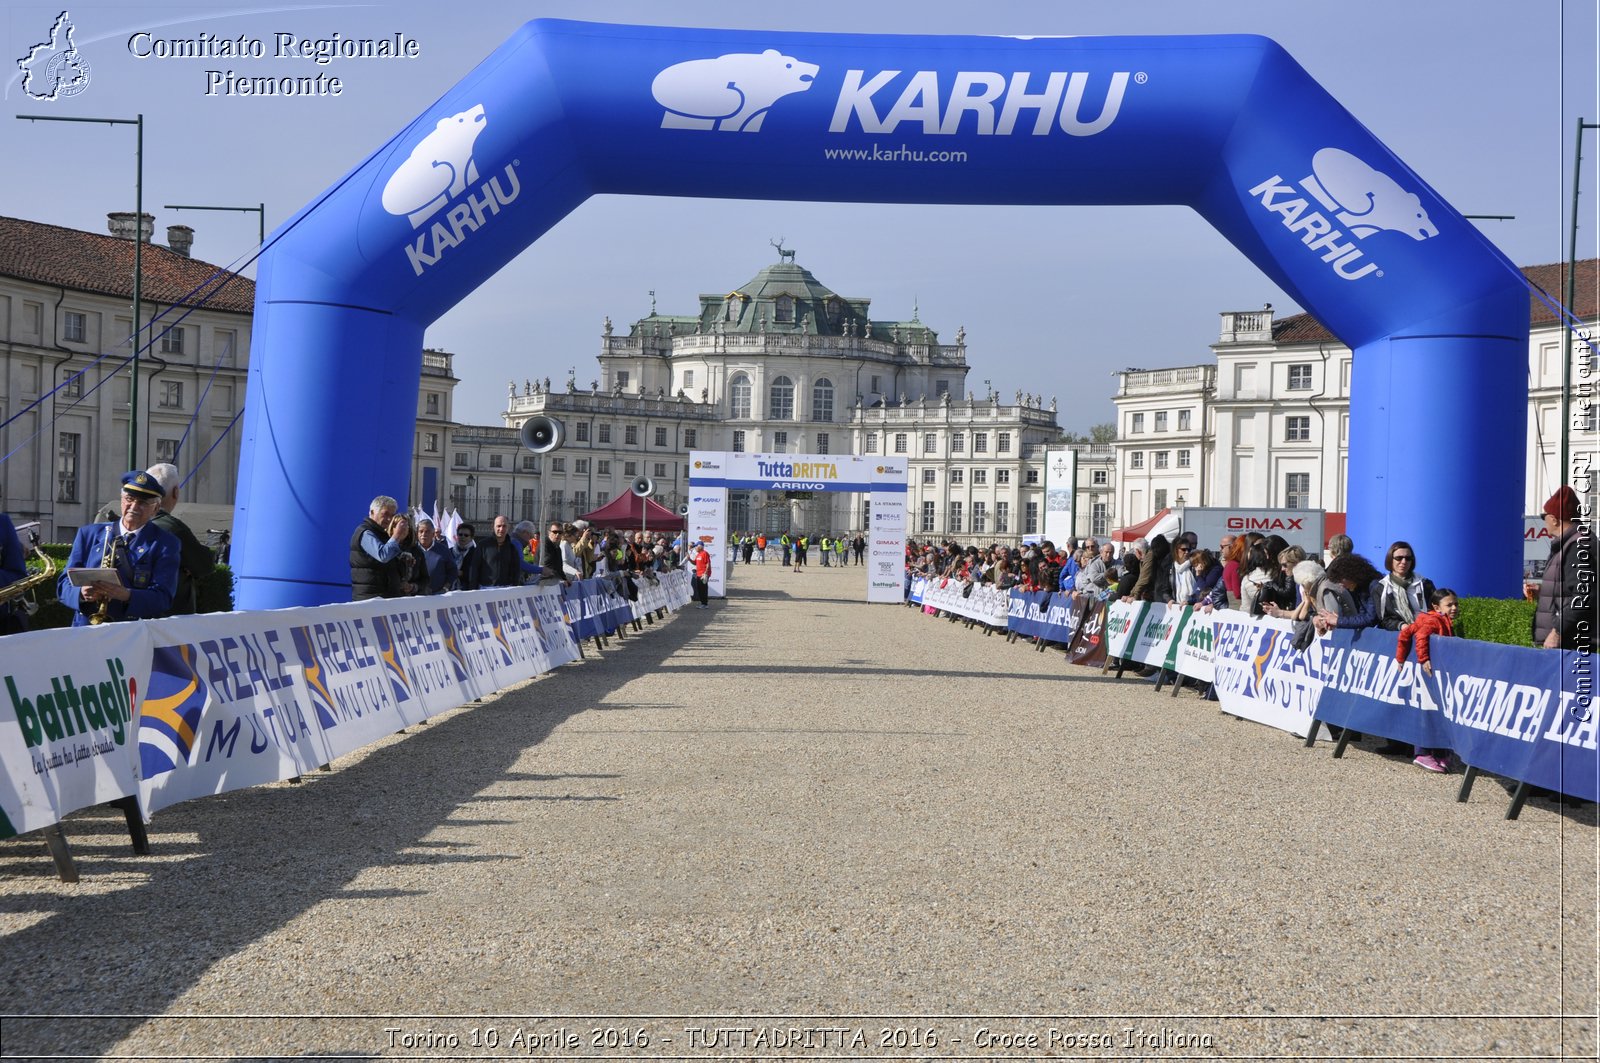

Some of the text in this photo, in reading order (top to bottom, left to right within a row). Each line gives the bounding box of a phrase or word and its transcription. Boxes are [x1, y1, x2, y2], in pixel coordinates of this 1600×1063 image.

[828, 69, 1130, 137] KARHU
[824, 143, 968, 163] www.karhu.com
[404, 163, 521, 277] KARHU
[1248, 174, 1379, 281] KARHU
[771, 482, 826, 490] ARRIVO
[1227, 517, 1303, 530] GIMAX
[390, 609, 441, 658] REALE
[450, 603, 491, 644] REALE
[498, 598, 531, 633] REALE
[313, 618, 377, 676] REALE
[465, 645, 502, 677] MUTUA
[509, 635, 541, 663] MUTUA
[1217, 623, 1259, 661] REALE
[199, 630, 294, 704] REALE
[408, 659, 453, 697] MUTUA
[1341, 648, 1438, 711] STAMPA
[333, 676, 390, 723] MUTUA
[1264, 676, 1320, 717] MUTU
[1434, 670, 1600, 750] LA STAMPA LA
[205, 700, 312, 763] MUTUA
